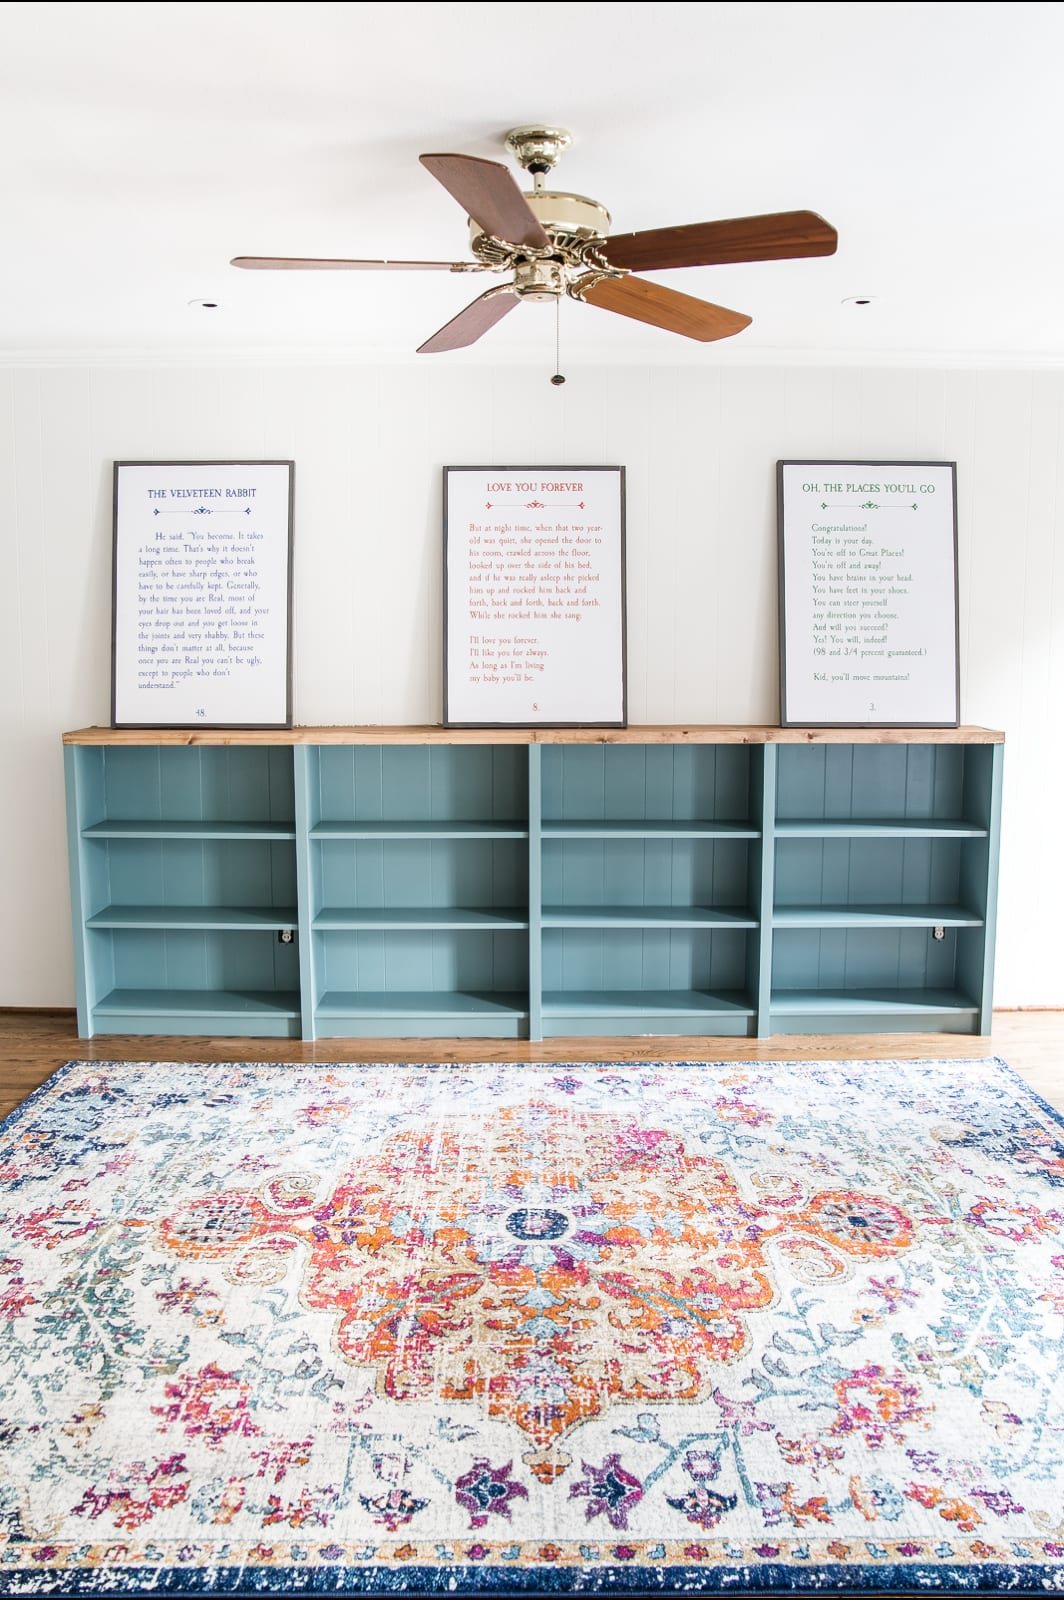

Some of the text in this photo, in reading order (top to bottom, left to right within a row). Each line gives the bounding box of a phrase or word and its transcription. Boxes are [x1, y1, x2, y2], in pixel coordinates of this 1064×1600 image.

[487, 482, 584, 492] LOVE YOU FOREVER
[802, 483, 820, 493] OH,
[823, 483, 843, 492] THE
[846, 483, 881, 493] PLACES
[920, 484, 935, 493] GO
[148, 488, 257, 498] THE VELVETEEN RABBIT
[155, 532, 167, 541] He
[239, 531, 244, 540] It
[247, 532, 264, 540] takes
[469, 536, 481, 544] old
[521, 536, 532, 544] she
[534, 536, 559, 546] opened
[561, 536, 573, 544] the
[575, 536, 594, 544] door
[811, 534, 832, 546] Today
[843, 539, 859, 547] your
[145, 545, 161, 556] long
[183, 544, 204, 552] That's
[206, 544, 220, 554] why
[230, 544, 255, 552] doesn't
[812, 548, 833, 556] You're
[836, 548, 846, 557] off
[858, 548, 879, 557] Great
[139, 557, 163, 568] happen
[164, 557, 183, 565] often
[195, 557, 217, 567] people
[219, 556, 234, 565] who
[237, 556, 255, 565] break
[812, 559, 833, 569] You're
[836, 561, 847, 569] off
[849, 561, 861, 569] and
[491, 598, 507, 607] back
[510, 598, 523, 606] and
[548, 598, 564, 606] back
[566, 598, 579, 606] and
[812, 598, 826, 606] You
[862, 598, 888, 608] yourself
[156, 606, 169, 615] hair
[171, 606, 183, 615] has
[186, 606, 202, 615] been
[204, 606, 222, 615] loved
[239, 606, 251, 614] and
[254, 608, 269, 616] your
[469, 610, 491, 619] While
[493, 611, 505, 619] she
[508, 611, 531, 619] rocked
[534, 611, 548, 619] him
[550, 610, 562, 619] she
[812, 613, 824, 621] any
[826, 611, 857, 619] direction
[154, 619, 171, 630] drop
[187, 619, 200, 627] and
[202, 621, 215, 629] you
[217, 621, 228, 629] get
[812, 623, 827, 631] And
[829, 623, 842, 631] will
[138, 631, 149, 639] the
[172, 631, 186, 639] and
[233, 630, 245, 639] But
[247, 630, 265, 639] these
[470, 635, 479, 644] I'll
[482, 636, 496, 644] love
[830, 635, 844, 643] You
[138, 643, 158, 655] things
[161, 643, 179, 652] don't
[228, 643, 254, 651] because
[470, 648, 479, 656] I'll
[482, 648, 495, 656] like
[512, 648, 523, 656] for
[813, 647, 826, 656] (98
[829, 648, 841, 656] and
[844, 647, 858, 656] 3/4
[860, 650, 884, 659] percent
[156, 659, 169, 667] you
[185, 656, 200, 664] Real
[201, 658, 214, 667] you
[217, 655, 233, 664] can't
[235, 656, 244, 664] be
[470, 661, 479, 669] As
[482, 661, 498, 672] long
[511, 661, 522, 669] I'm
[525, 661, 545, 672] living
[470, 676, 481, 684] my
[483, 673, 500, 684] baby
[502, 673, 522, 684] you'll
[832, 673, 850, 682] you'll
